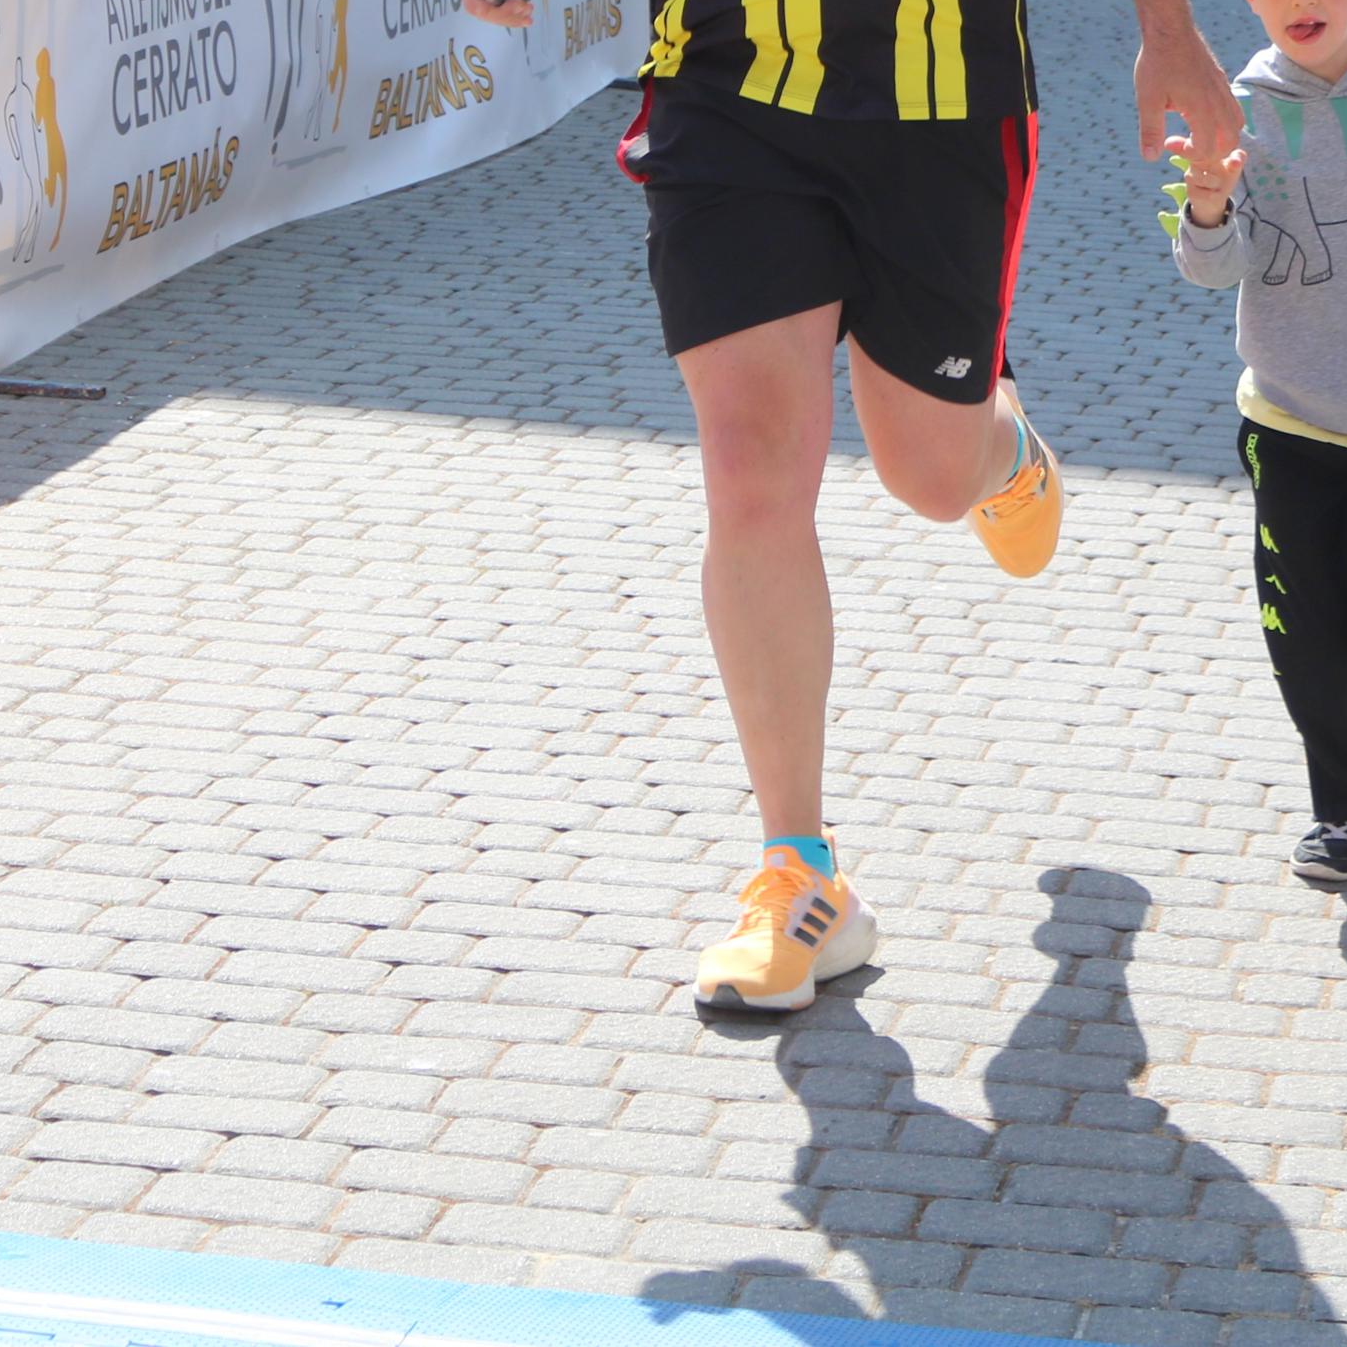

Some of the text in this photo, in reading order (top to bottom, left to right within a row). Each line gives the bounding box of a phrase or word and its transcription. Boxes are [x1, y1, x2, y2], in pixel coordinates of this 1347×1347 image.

[111, 20, 237, 136] CERRATO
[369, 37, 493, 140] BALTANÁS
[96, 126, 240, 255] BALTANÁS
